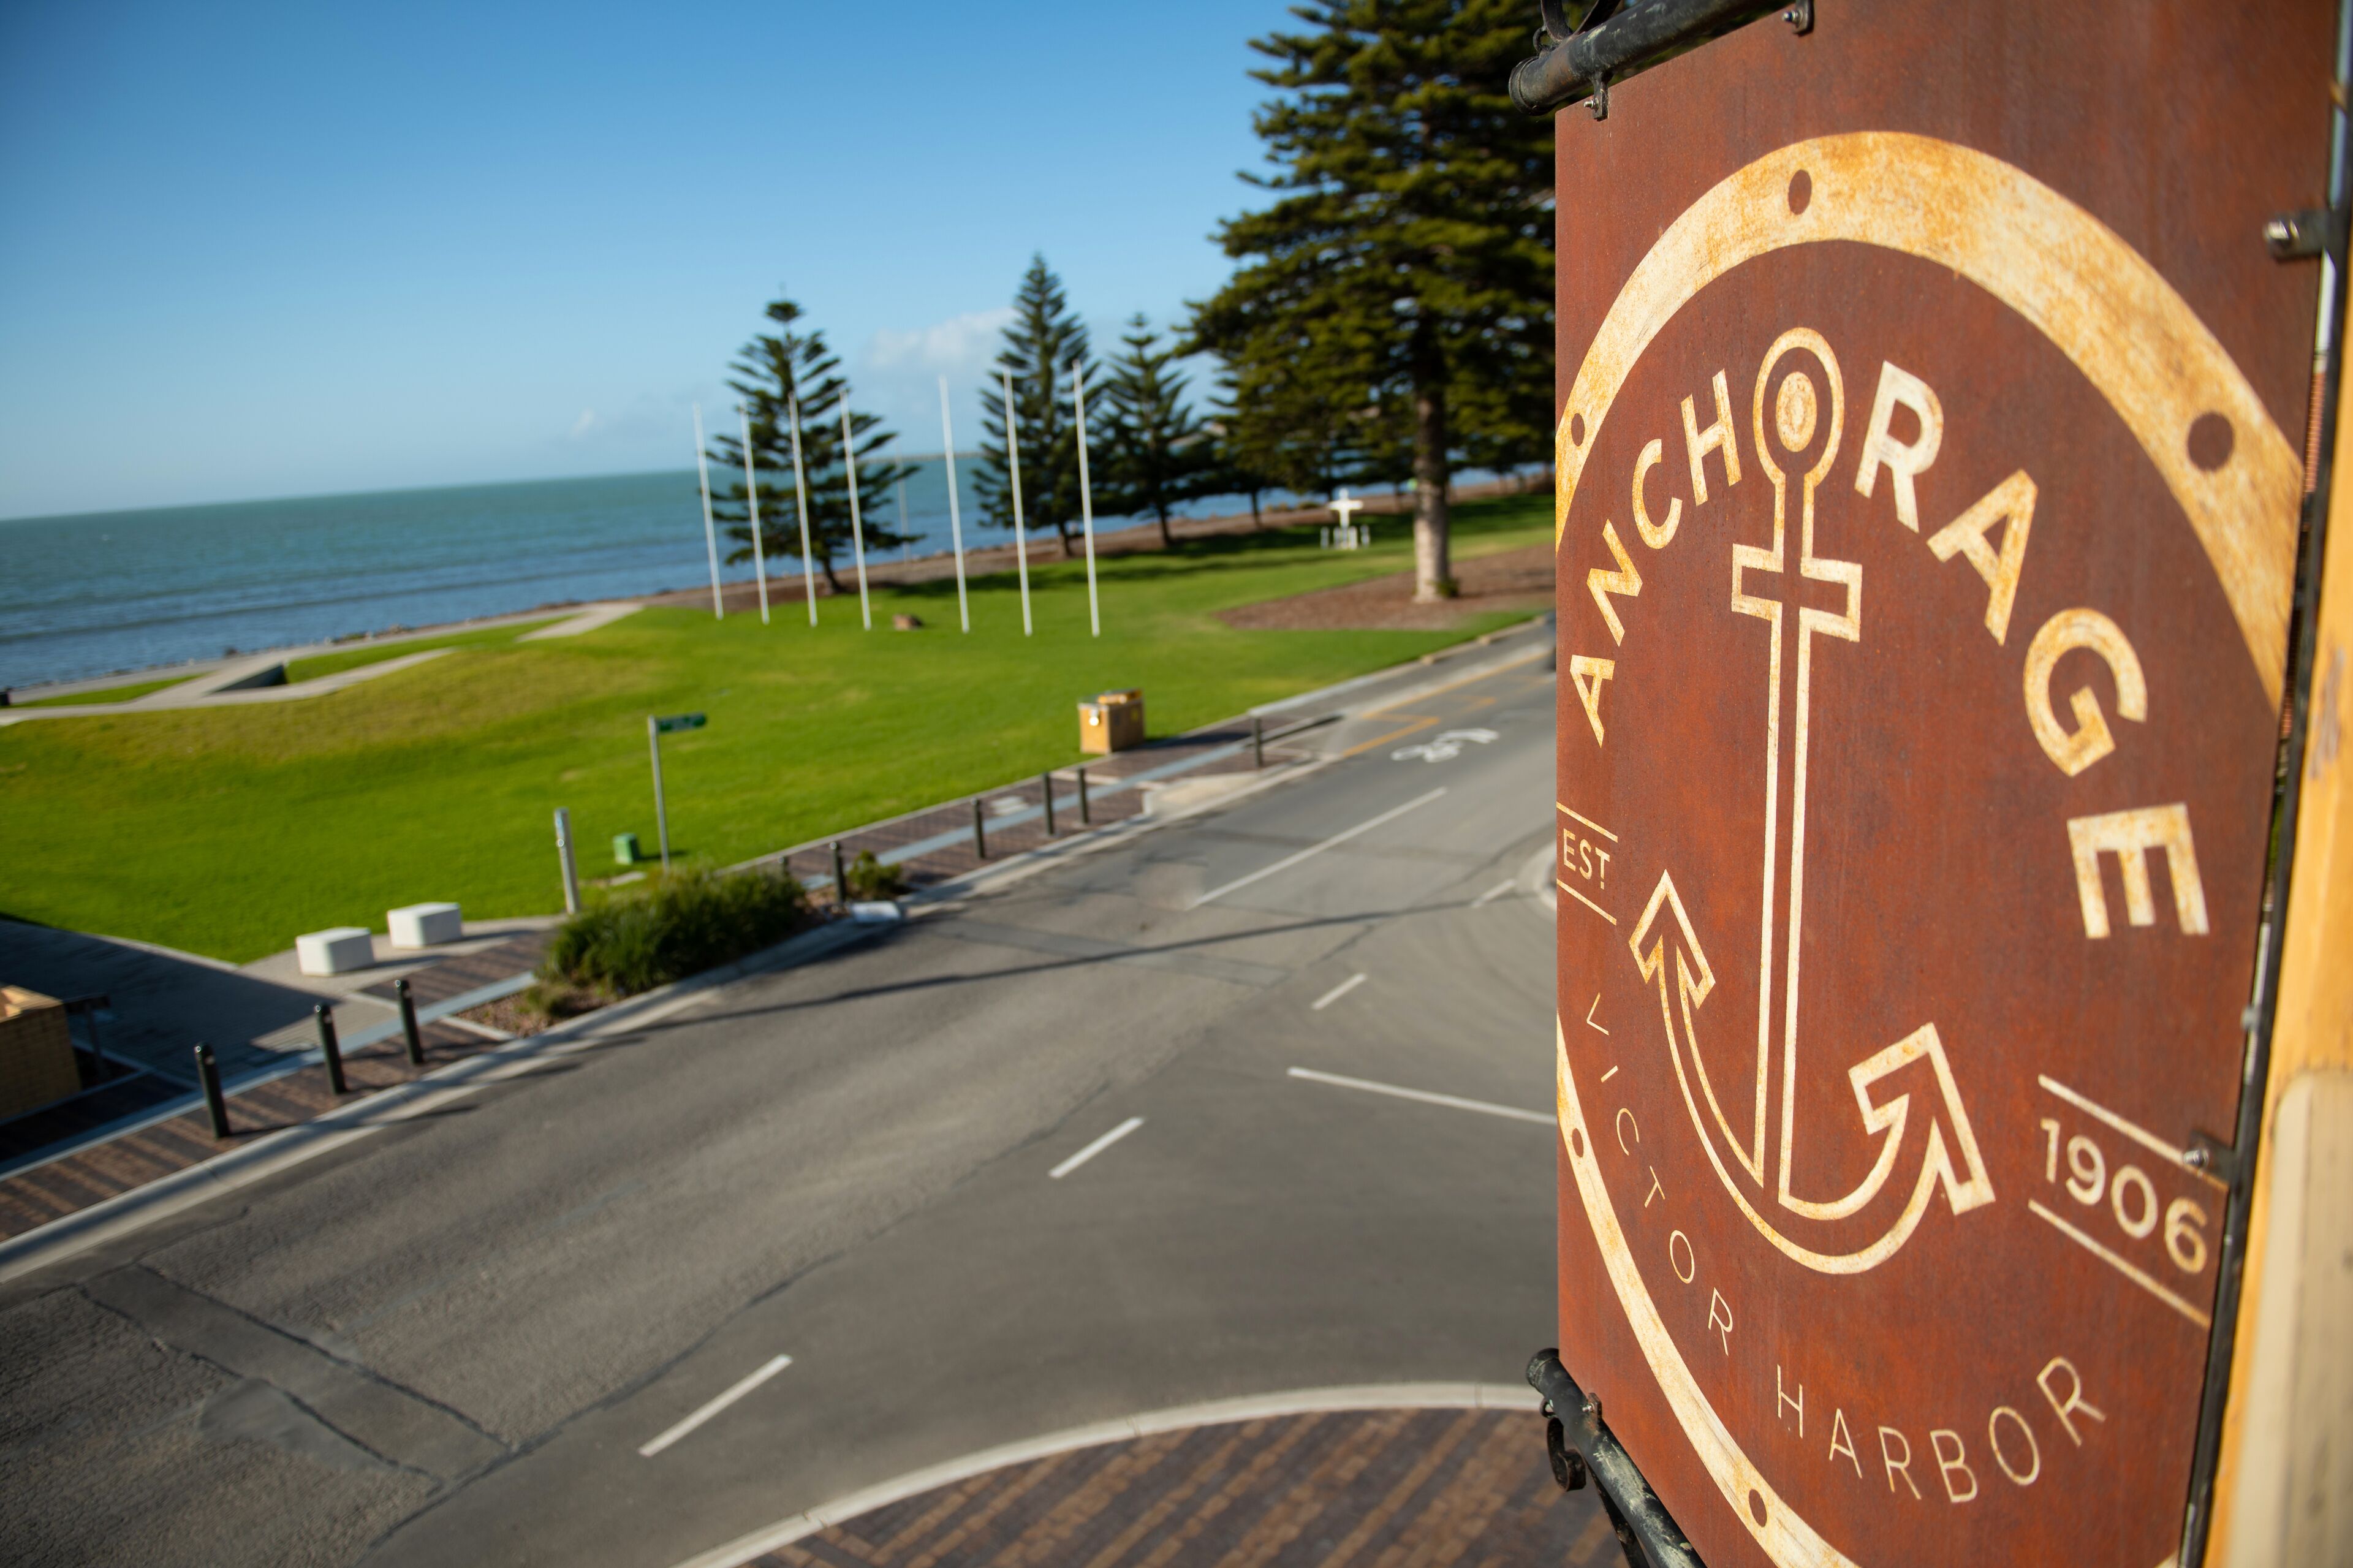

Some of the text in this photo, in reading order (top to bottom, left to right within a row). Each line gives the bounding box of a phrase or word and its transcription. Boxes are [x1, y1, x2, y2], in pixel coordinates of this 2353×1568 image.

[1569, 327, 2210, 939] ANCHORAGE
[1586, 992, 2106, 1503] VICTOR HARBOR
[2039, 1117, 2207, 1274] 1906
